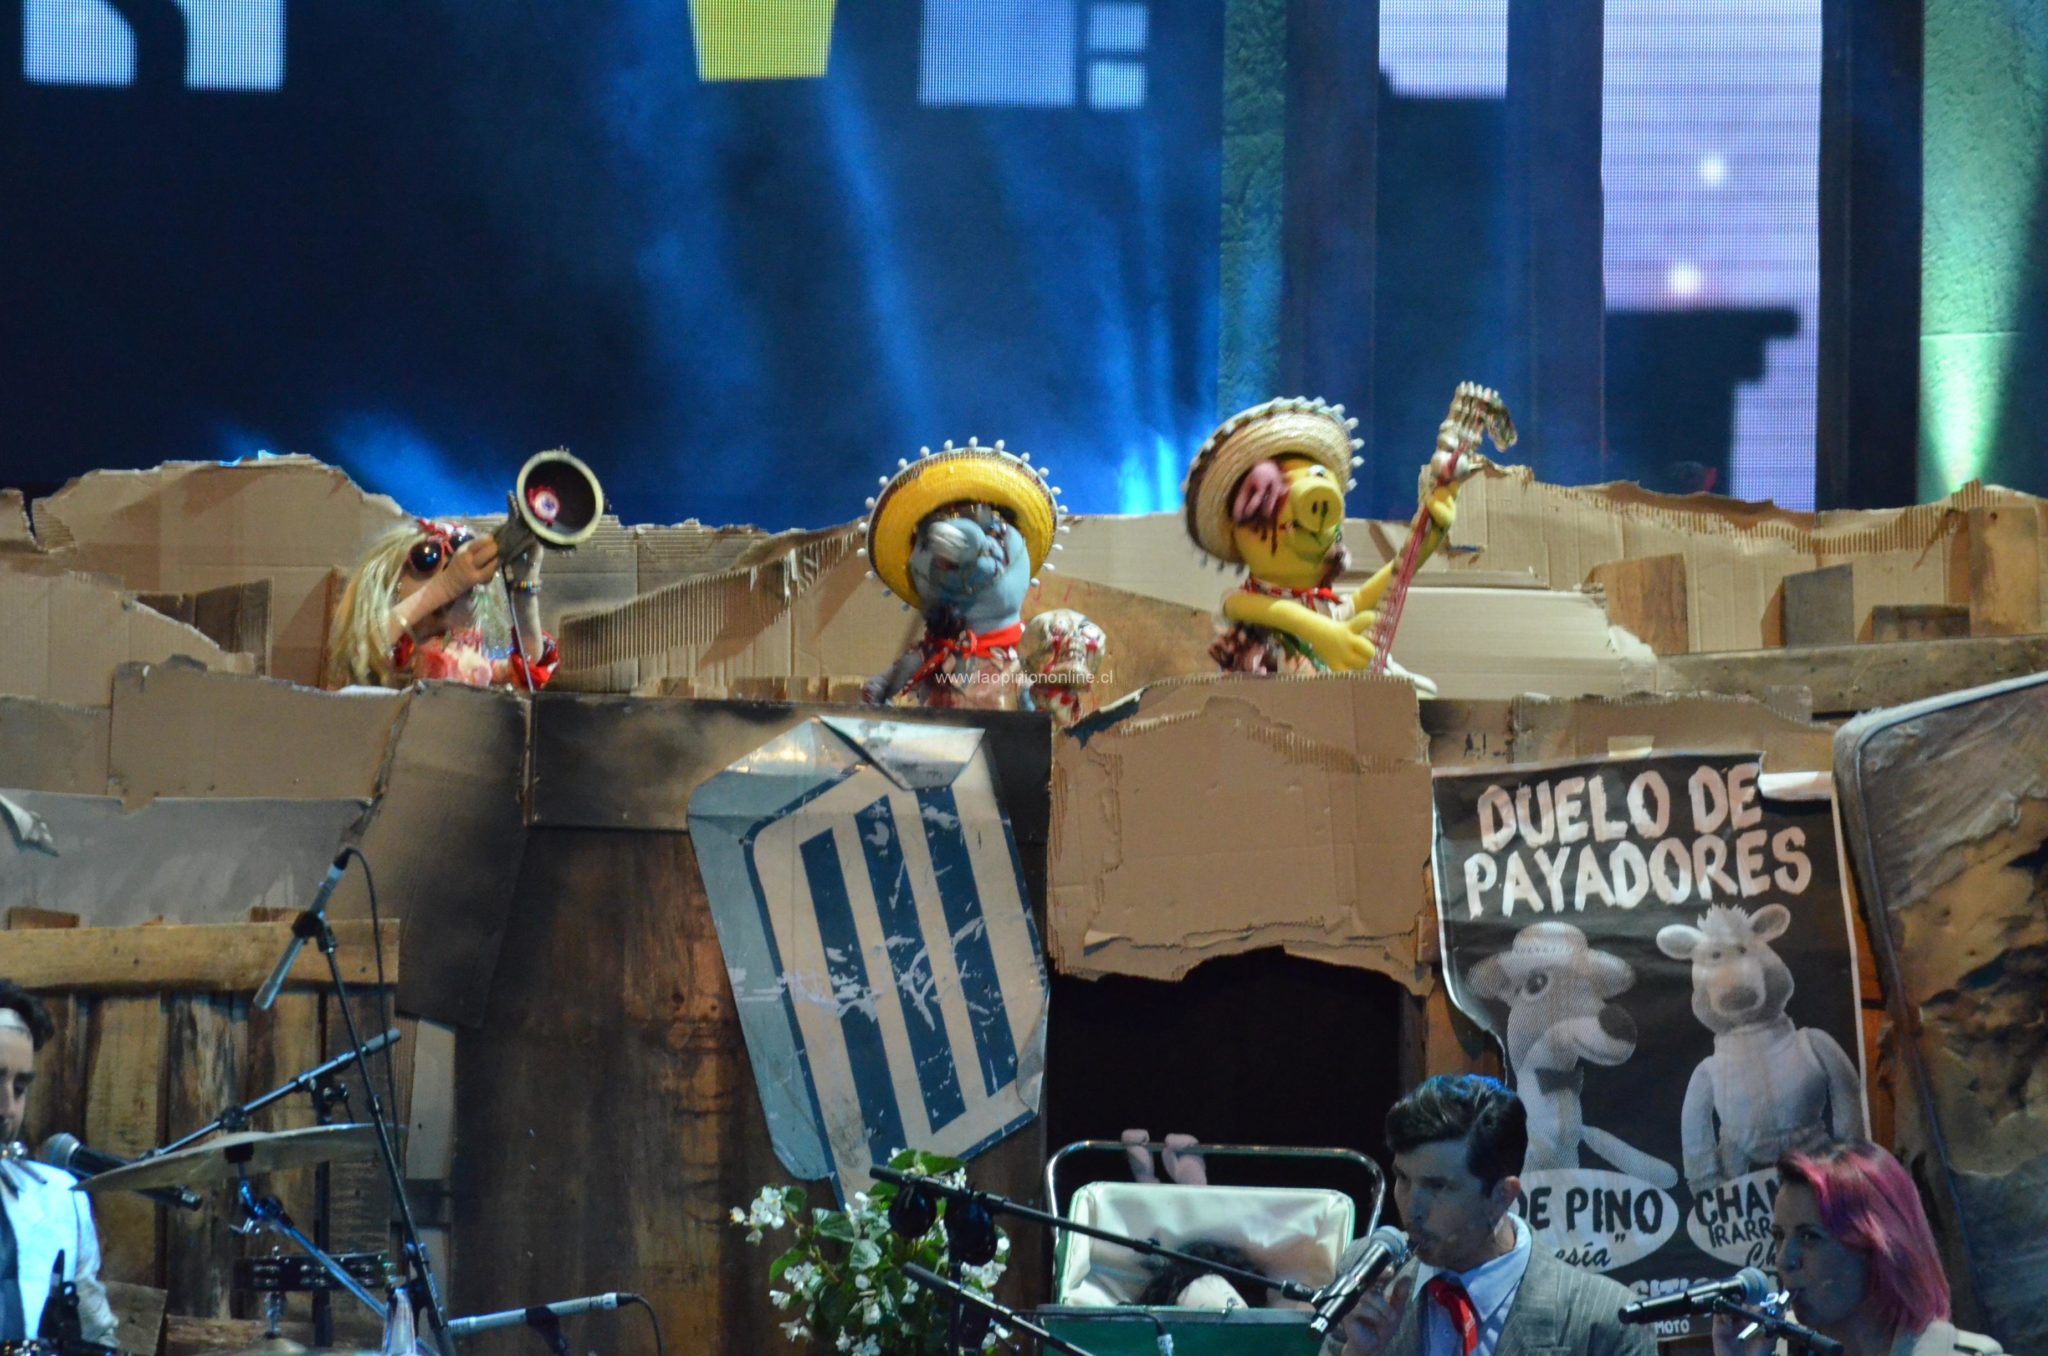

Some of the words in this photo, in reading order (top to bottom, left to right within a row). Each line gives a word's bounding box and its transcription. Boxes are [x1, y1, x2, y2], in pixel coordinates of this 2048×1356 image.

[1477, 771, 1670, 852] DUELO
[1688, 763, 1763, 833] DE
[1463, 826, 1812, 920] PAYADORES
[1565, 1187, 1664, 1235] PINO
